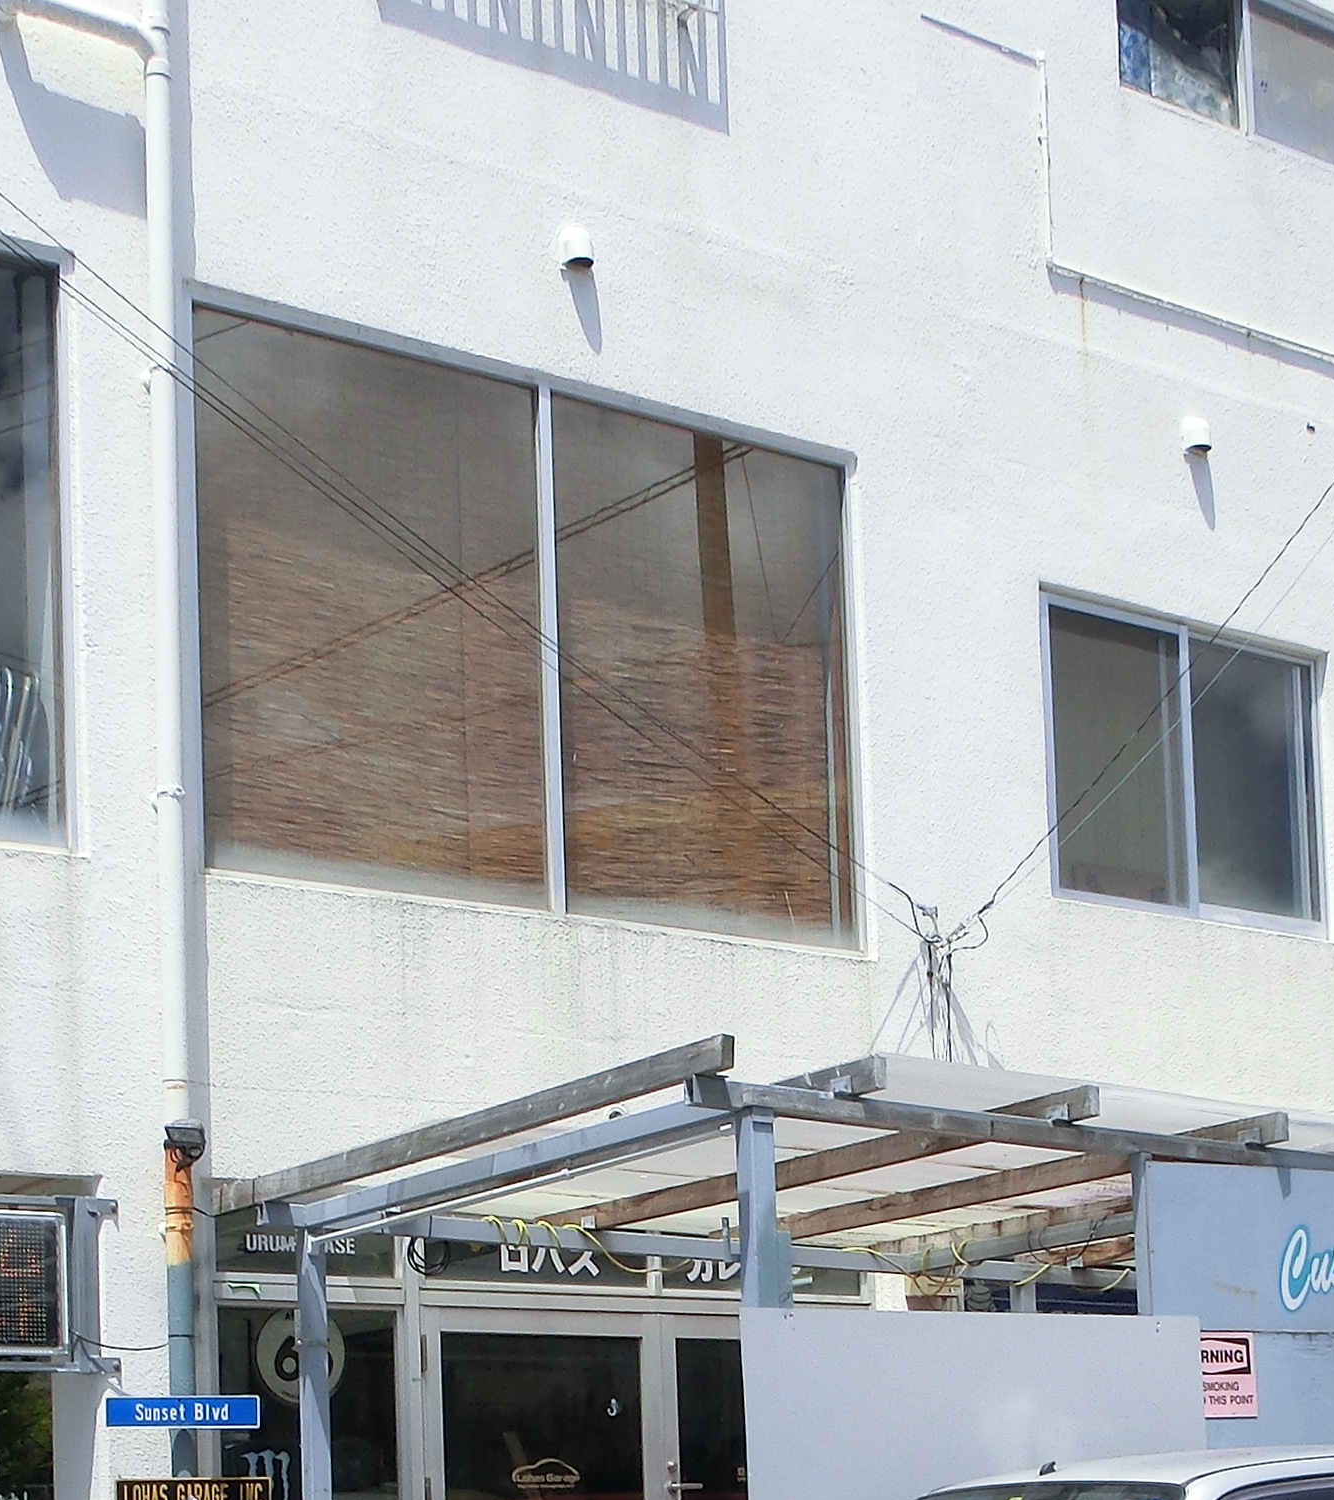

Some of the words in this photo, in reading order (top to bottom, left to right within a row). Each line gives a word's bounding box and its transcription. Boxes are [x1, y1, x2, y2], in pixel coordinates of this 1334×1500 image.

[246, 1233, 298, 1252] URUM
[323, 1237, 356, 1255] ASE
[501, 1244, 600, 1278] ロハス
[1200, 1350, 1244, 1363] RNING
[1209, 1395, 1227, 1405] THIS
[1230, 1395, 1254, 1405] POINT
[134, 1404, 186, 1421] Sunset
[194, 1403, 230, 1421] Blvd
